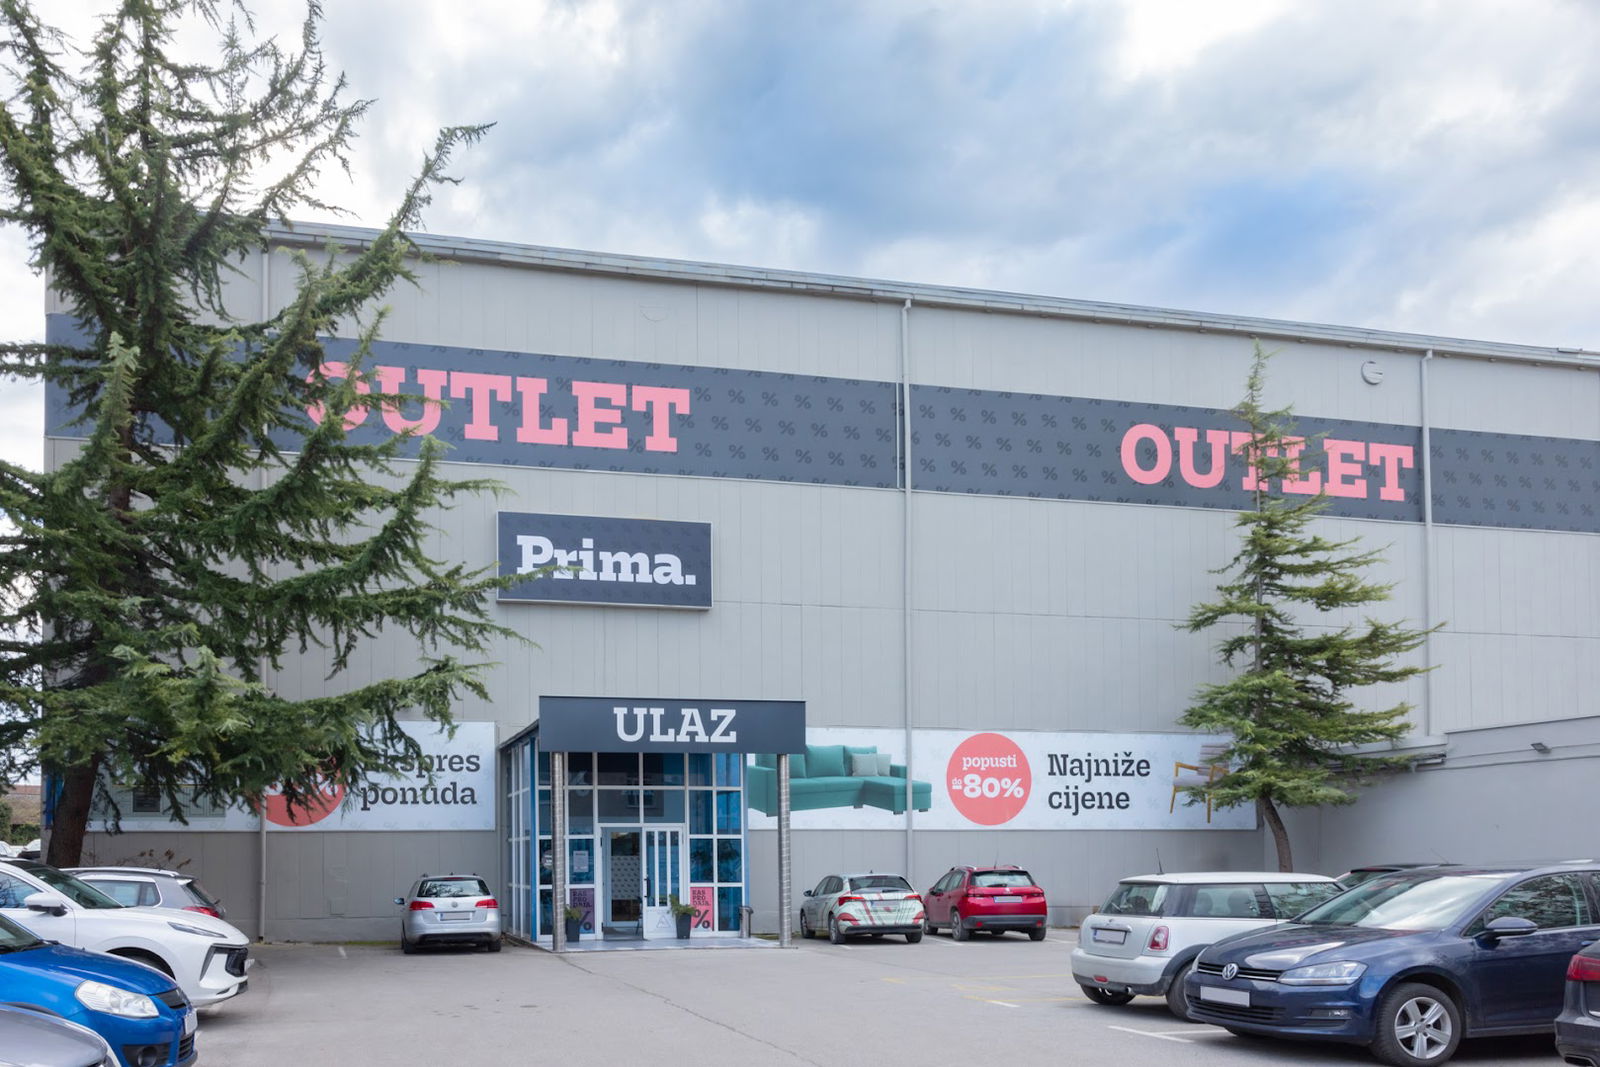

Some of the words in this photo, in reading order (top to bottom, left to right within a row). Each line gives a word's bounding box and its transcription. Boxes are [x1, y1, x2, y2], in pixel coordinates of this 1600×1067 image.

[305, 361, 690, 453] OUTLET
[1120, 423, 1414, 502] OUTLET
[516, 534, 697, 586] Prima.
[613, 707, 737, 743] ULAZ
[362, 749, 481, 779] kspres
[962, 754, 1017, 771] popusti
[1047, 751, 1151, 783] Najniže
[360, 781, 478, 812] ponuda
[1047, 786, 1131, 816] cijene
